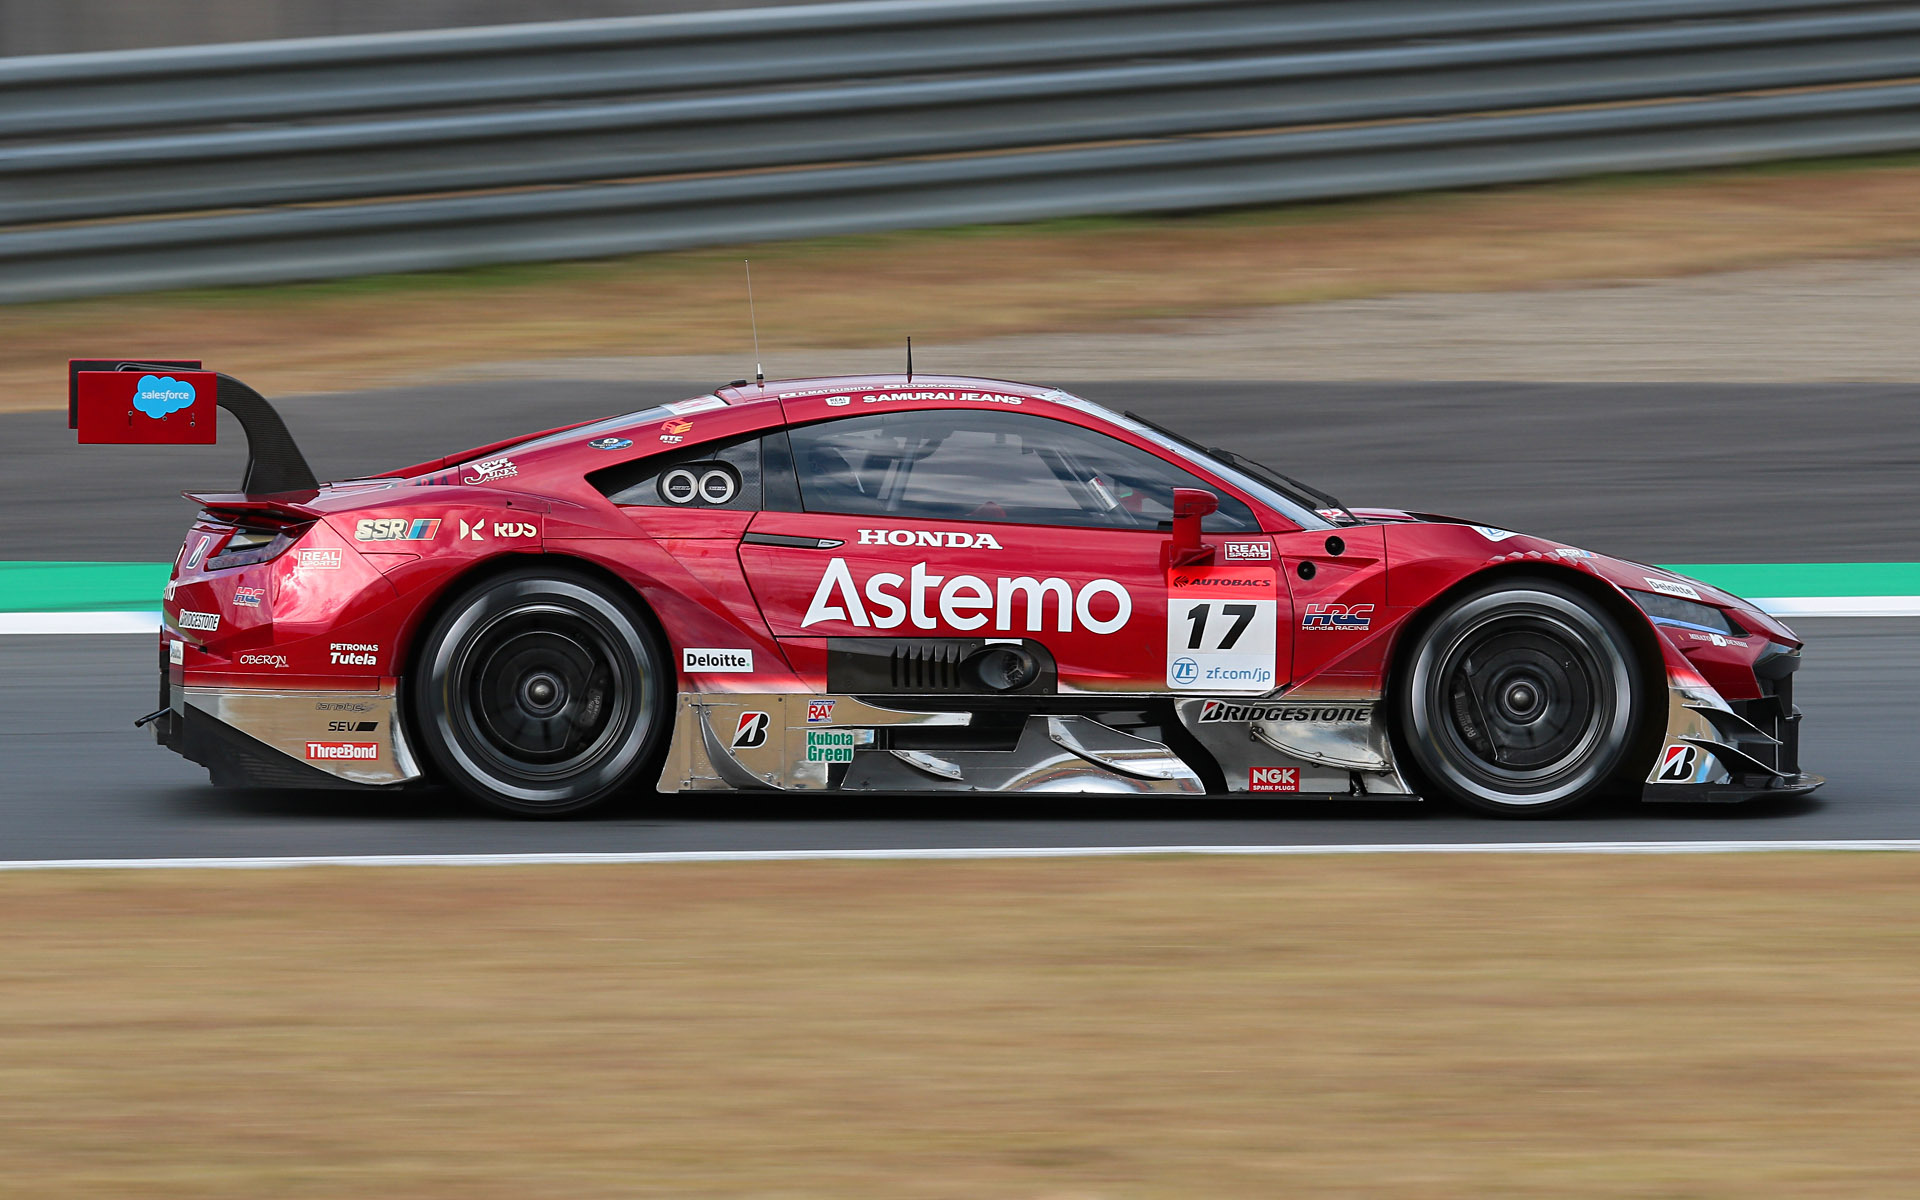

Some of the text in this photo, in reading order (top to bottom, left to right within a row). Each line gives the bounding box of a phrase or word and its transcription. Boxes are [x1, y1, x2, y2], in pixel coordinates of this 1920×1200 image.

[141, 390, 190, 402] salesforce
[862, 392, 1025, 405] SAMURAI JEANS
[354, 519, 408, 540] SSR
[493, 522, 538, 538] RDS
[857, 529, 1003, 550] HONDA
[1228, 544, 1270, 552] REAL
[302, 551, 341, 561] REAL
[1191, 578, 1271, 587] AUTOBACS
[800, 557, 1132, 634] Astemo
[179, 609, 219, 630] BRIDGESTONE
[1302, 603, 1375, 626] HRC
[1187, 603, 1257, 650] 17
[330, 643, 379, 652] PETRONAS
[239, 654, 287, 669] OBERON
[330, 652, 377, 666] Tutela
[686, 653, 751, 667] Deloitte.
[1206, 668, 1271, 682] zf.com/jp
[1200, 701, 1370, 723] BRIDGESTONE
[328, 721, 356, 731] SEV
[808, 732, 853, 746] Kubota
[307, 744, 377, 759] ThreeBond
[808, 746, 852, 762] Green
[1252, 768, 1295, 784] NGK
